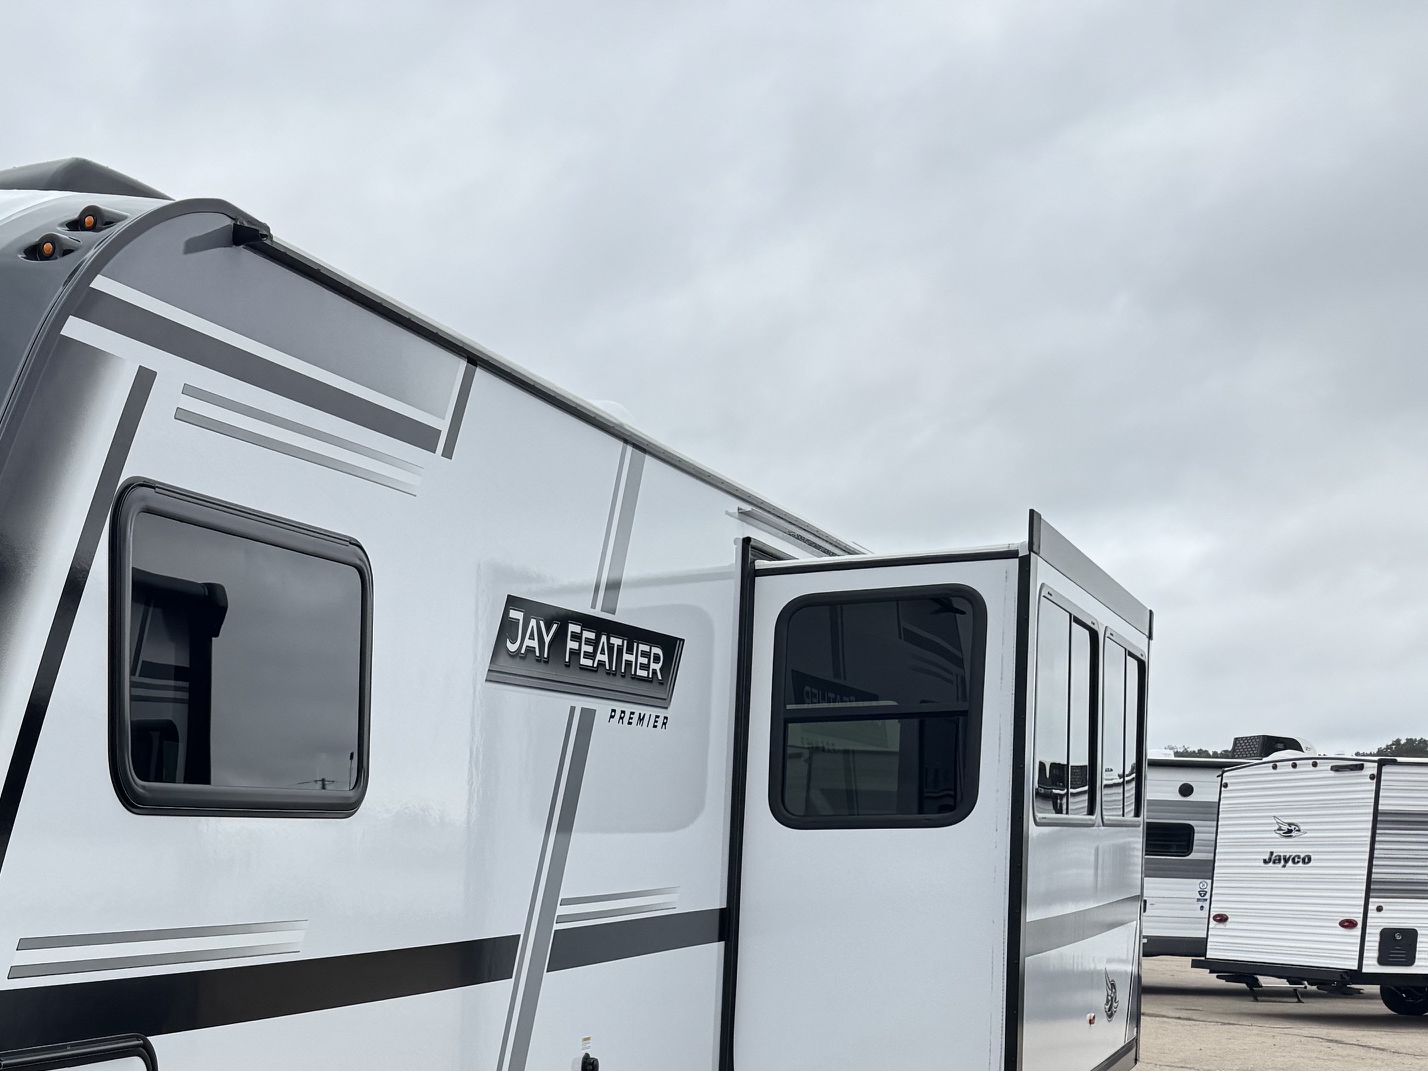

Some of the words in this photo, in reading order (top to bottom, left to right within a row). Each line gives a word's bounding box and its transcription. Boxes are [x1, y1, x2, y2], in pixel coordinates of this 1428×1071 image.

[506, 608, 560, 663] JAY
[564, 621, 664, 684] FEATHER
[608, 708, 669, 730] PREMIER
[1262, 851, 1312, 868] Jayco
